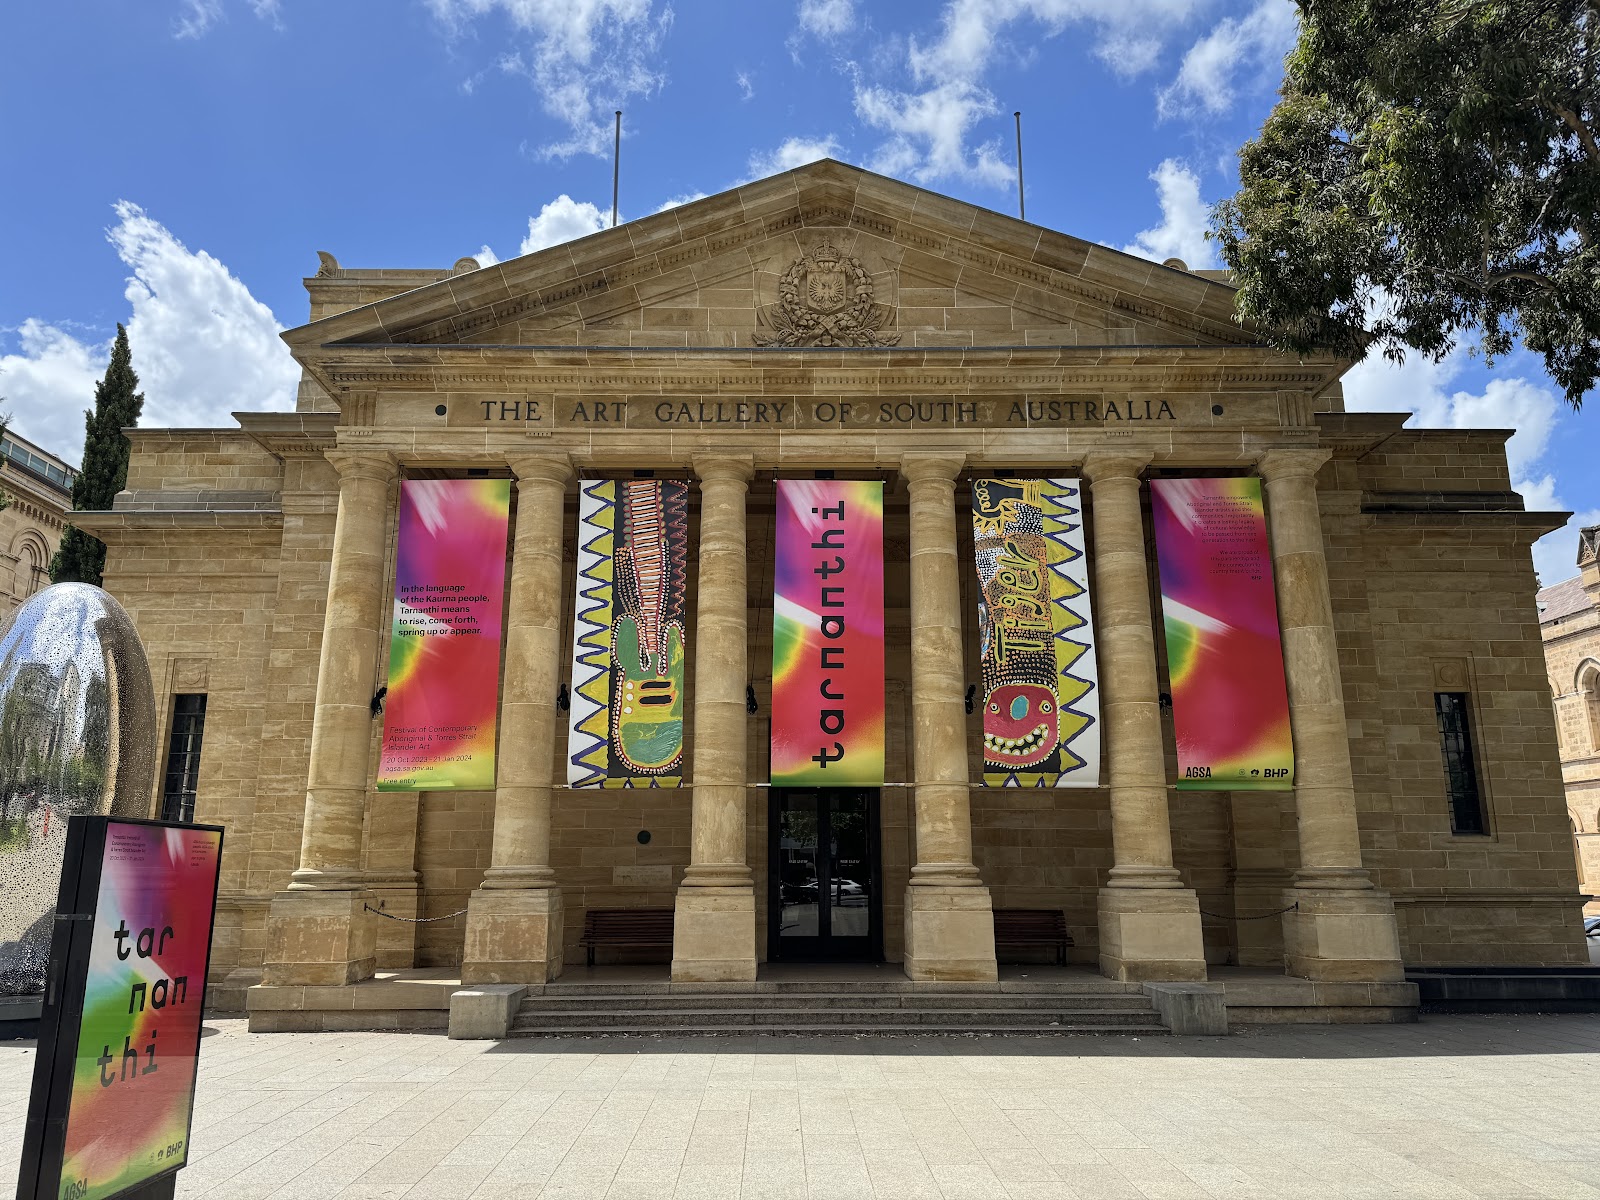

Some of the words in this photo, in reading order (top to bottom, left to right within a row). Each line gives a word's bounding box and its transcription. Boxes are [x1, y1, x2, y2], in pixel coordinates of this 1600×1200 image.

[480, 400, 542, 422] THE
[570, 401, 628, 422] ART
[655, 402, 788, 422] GALLERY
[815, 402, 853, 422] OF
[880, 402, 978, 423] SOUTH
[1006, 400, 1176, 422] AUSTRALIA
[426, 585, 465, 593] language
[458, 595, 489, 603] people,
[400, 606, 439, 614] Tarnanthi
[454, 616, 478, 624] forth,
[398, 628, 425, 637] spring
[450, 628, 481, 636] appear.
[811, 500, 845, 768] tarnanthi
[1185, 766, 1212, 778] AGSA
[1264, 768, 1288, 778] BHP
[114, 920, 174, 961] tar
[128, 976, 188, 1014] nan
[96, 1030, 158, 1088] thi
[166, 1140, 184, 1158] BHP
[62, 1176, 88, 1200] AGSA
